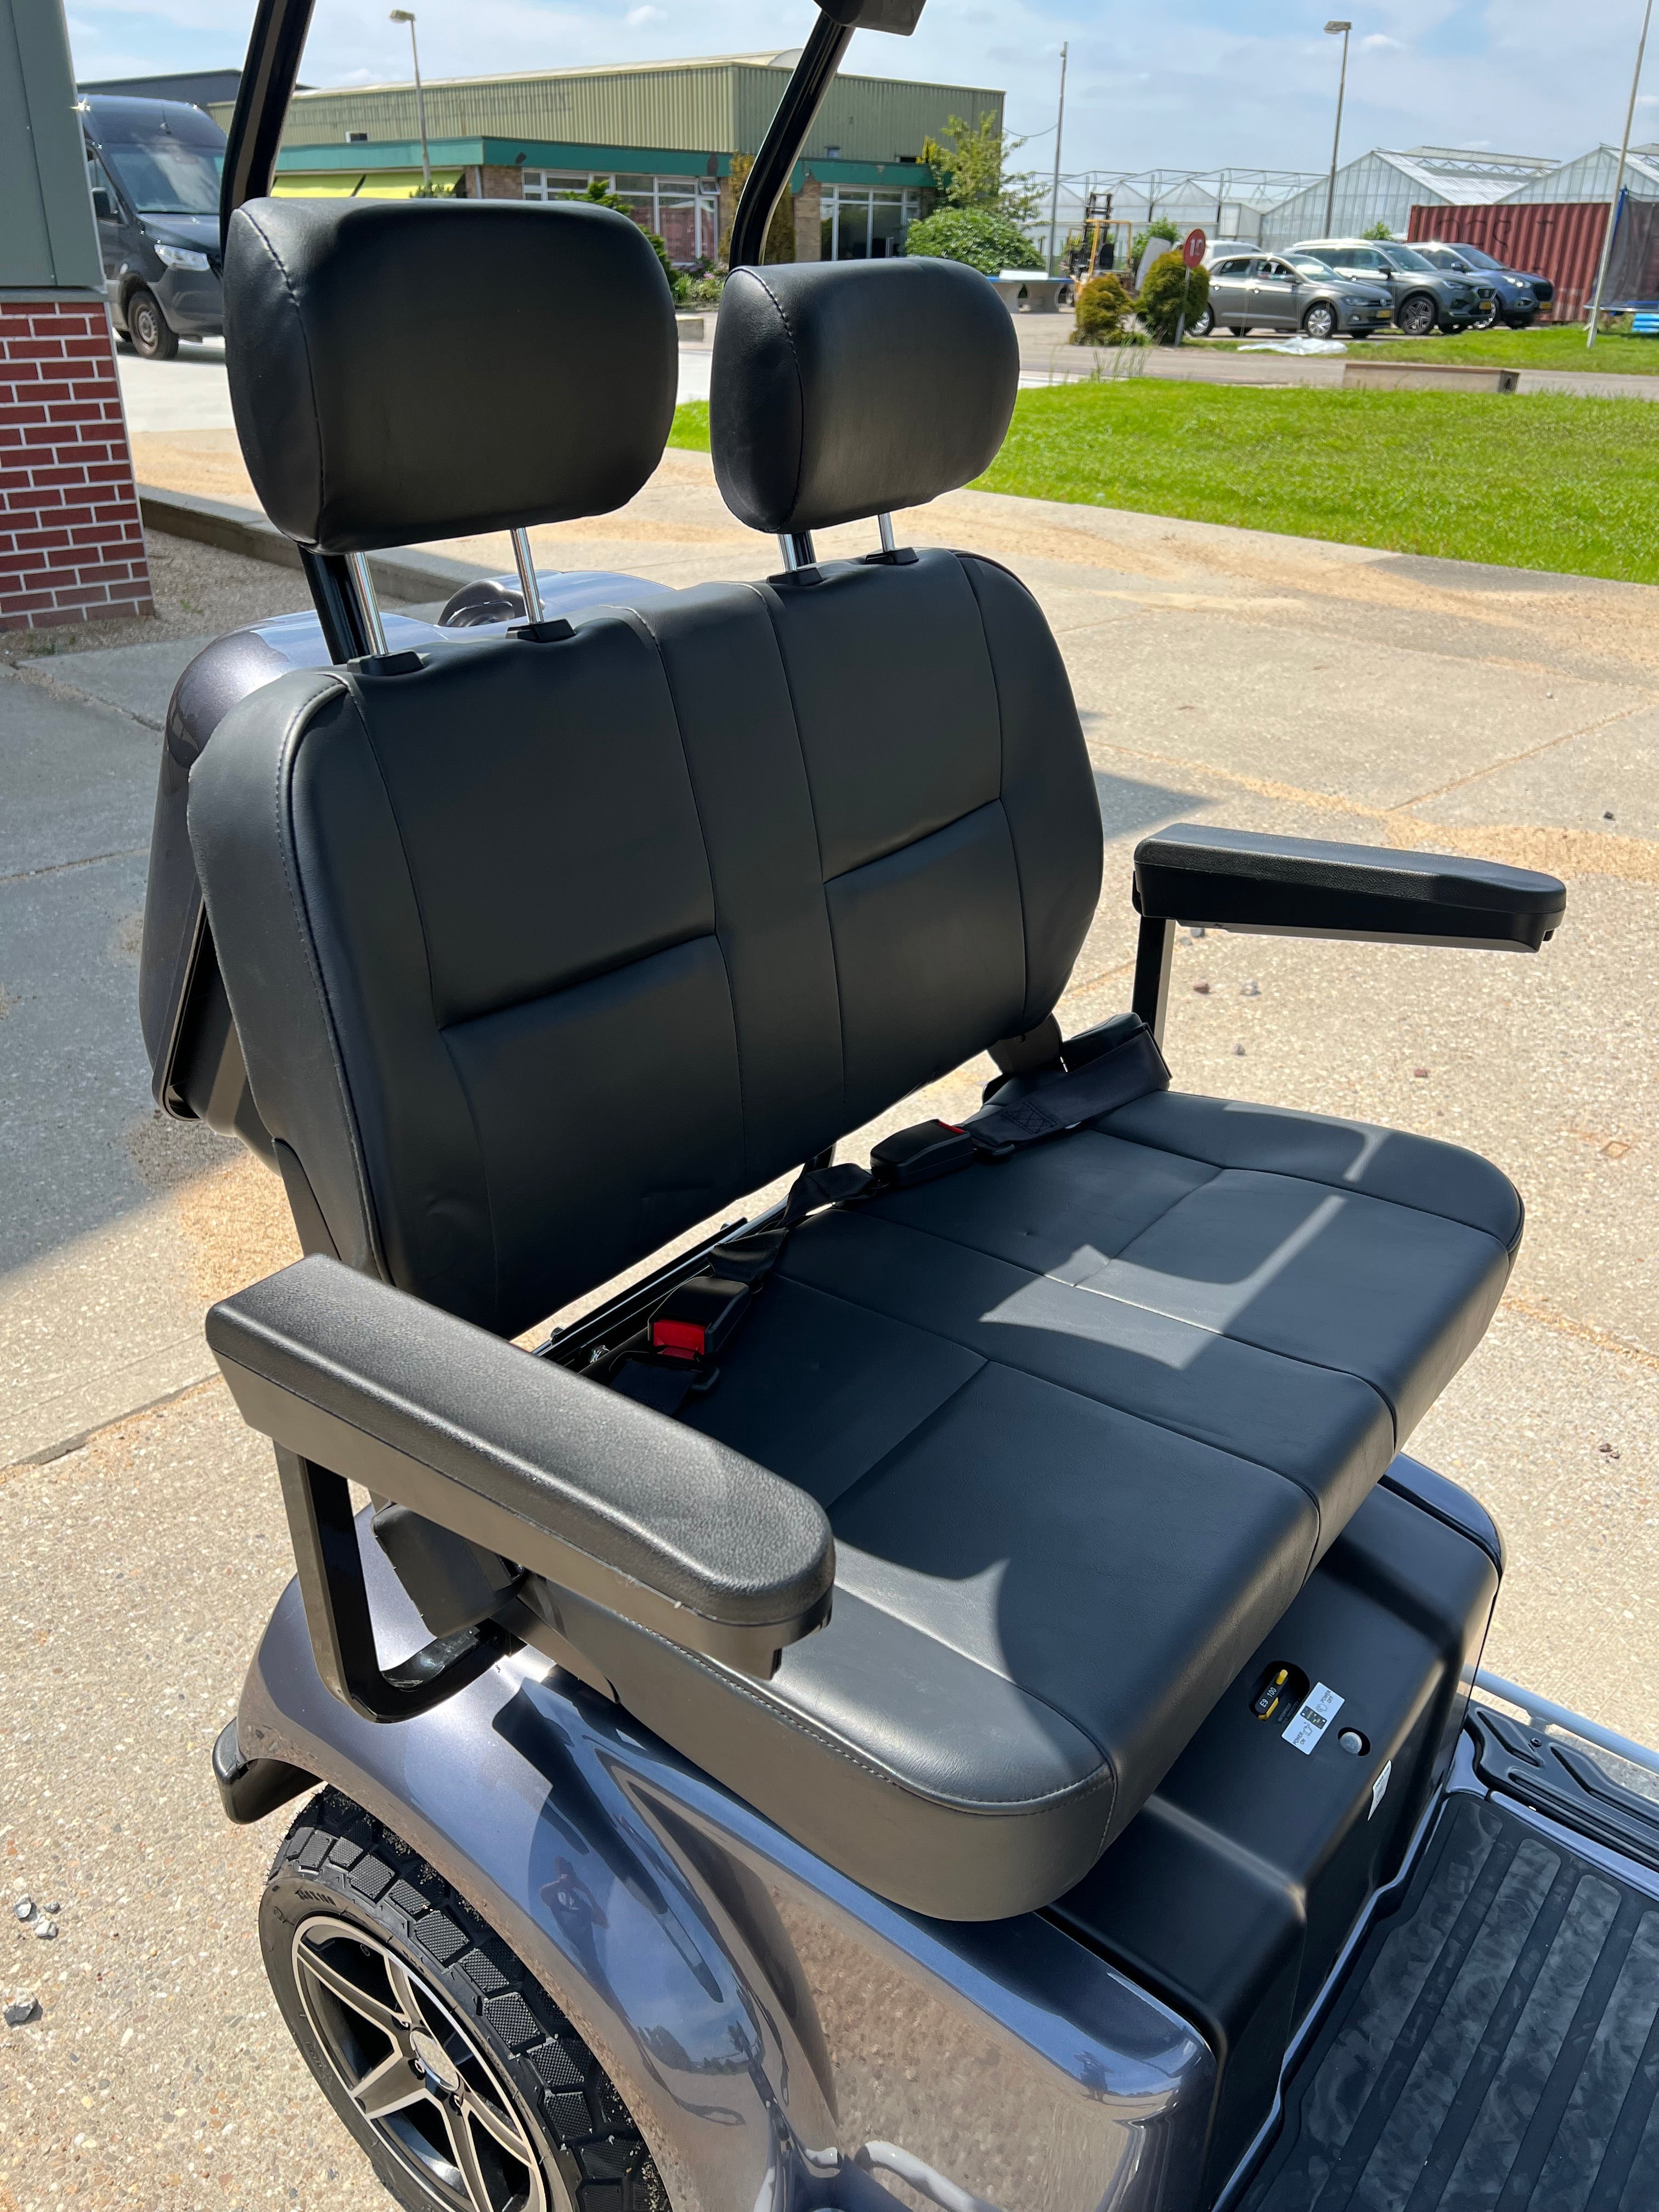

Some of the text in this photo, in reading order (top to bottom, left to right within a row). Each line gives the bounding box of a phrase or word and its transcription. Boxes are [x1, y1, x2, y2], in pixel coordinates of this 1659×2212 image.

[1259, 1687, 1277, 1707] E9 100
[1320, 1690, 1331, 1703] POWER
[1292, 1731, 1304, 1746] POWER
